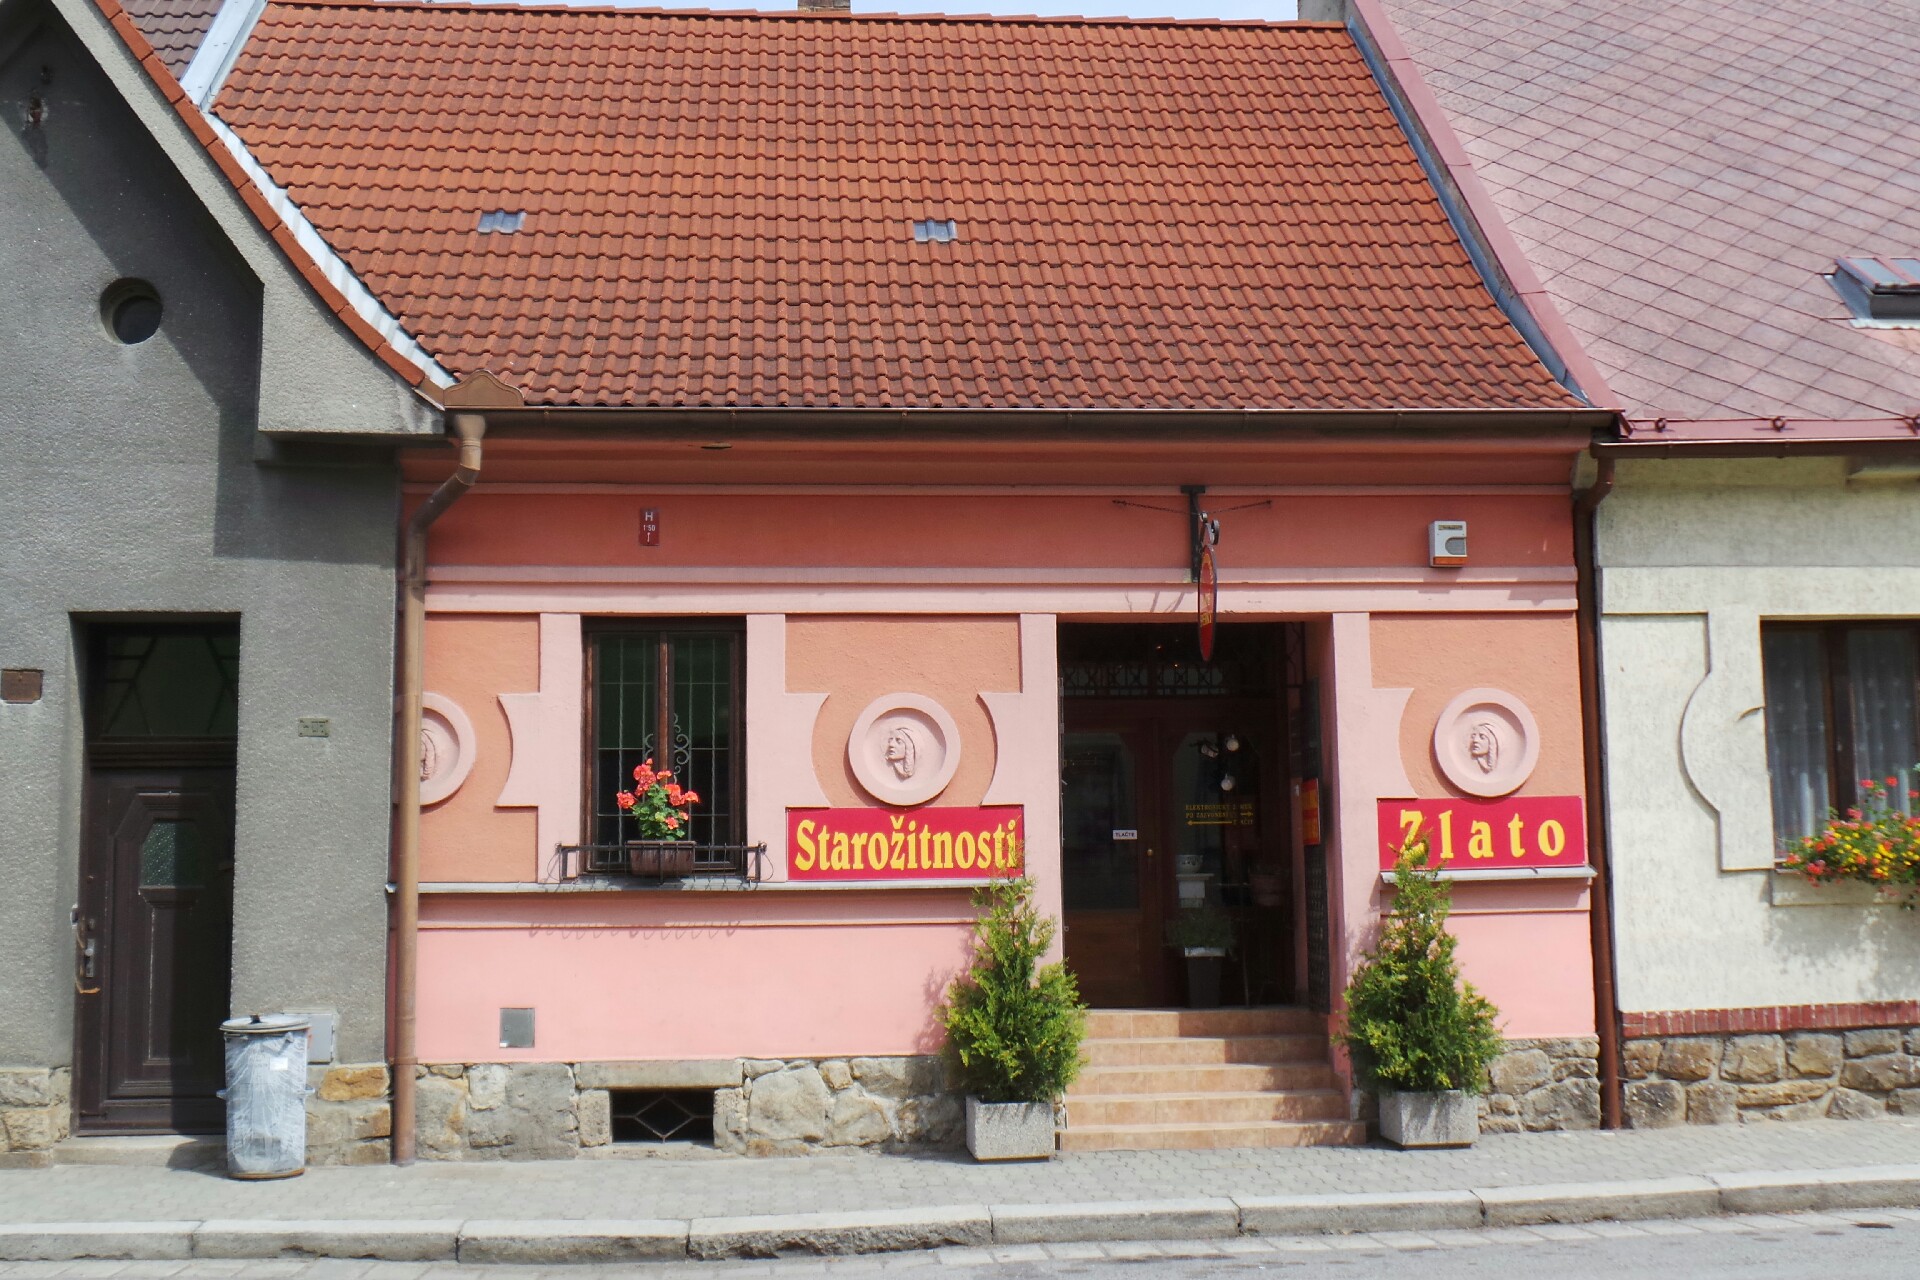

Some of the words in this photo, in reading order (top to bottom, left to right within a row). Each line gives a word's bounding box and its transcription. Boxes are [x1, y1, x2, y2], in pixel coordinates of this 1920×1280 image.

[645, 511, 653, 521] H
[794, 815, 1017, 871] Starožitnosti
[1399, 809, 1566, 859] Zlato
